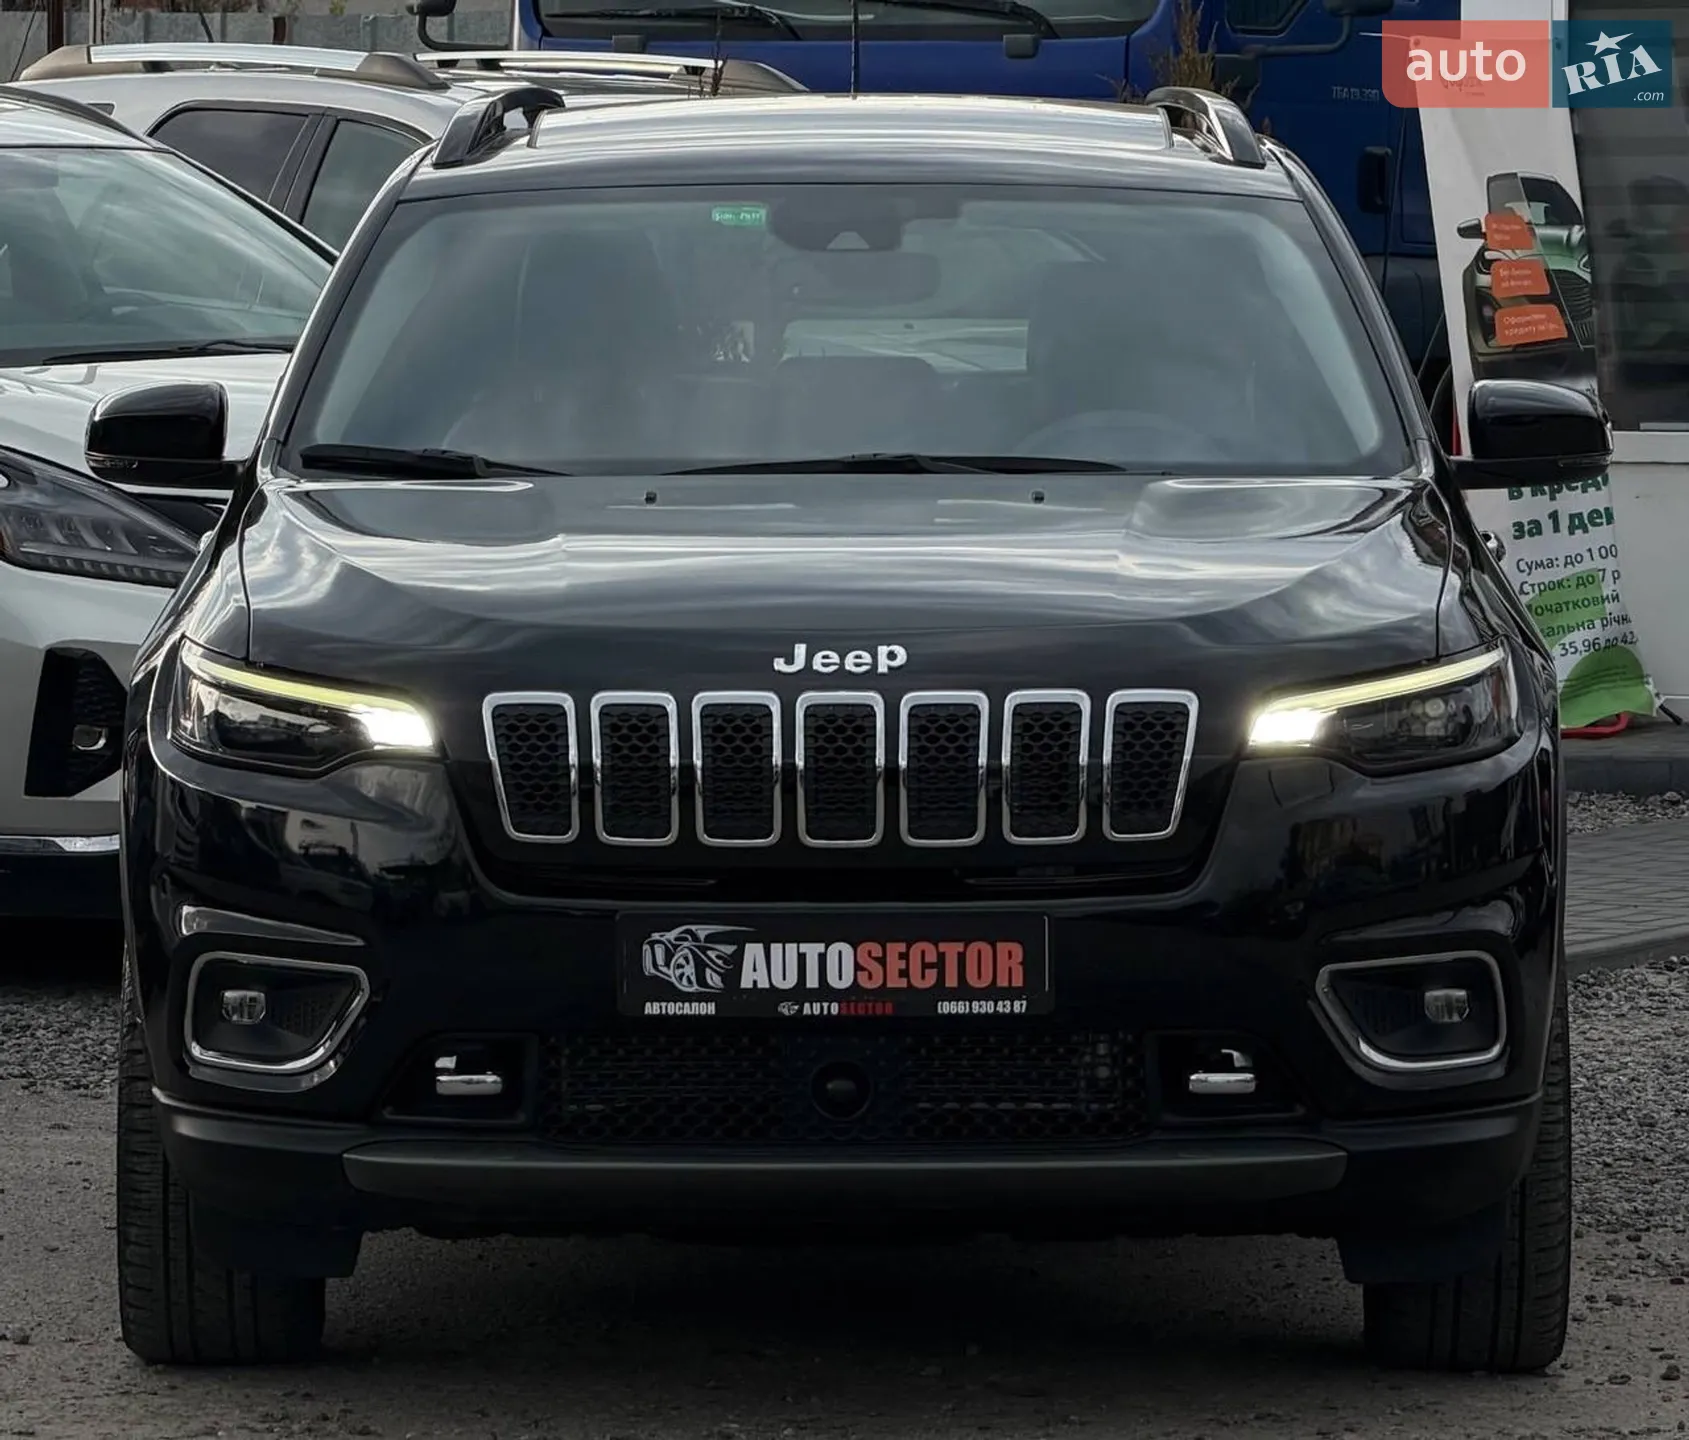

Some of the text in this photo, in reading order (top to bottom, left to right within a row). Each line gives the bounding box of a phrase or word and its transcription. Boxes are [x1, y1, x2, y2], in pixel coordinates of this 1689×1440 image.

[1512, 519, 1543, 540] за
[1548, 509, 1560, 533] 1
[1516, 557, 1560, 576] Сума:
[1563, 553, 1584, 568] до
[1519, 578, 1571, 597] Строк:
[1575, 574, 1595, 589] до
[1597, 568, 1606, 583] 7
[1601, 612, 1632, 630] річн
[773, 643, 908, 674] Jeep
[1558, 637, 1601, 657] 35,96
[1603, 637, 1619, 650] до
[740, 941, 1024, 989] AUTOSECTOR
[644, 1002, 716, 1015] АВТОСАЛОН
[938, 1000, 1027, 1014] (066) 930 43 87
